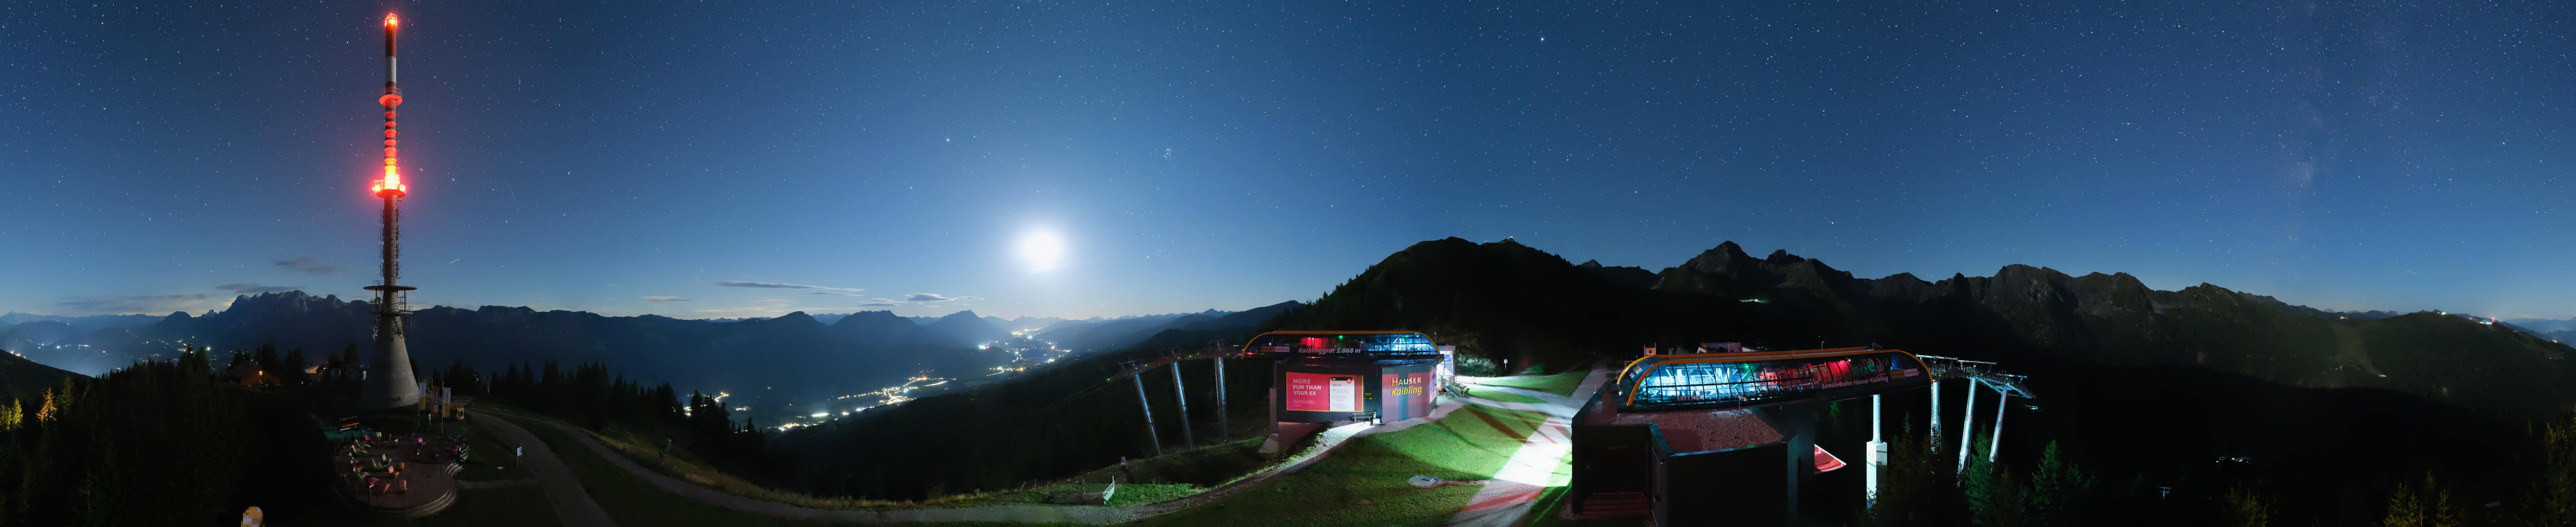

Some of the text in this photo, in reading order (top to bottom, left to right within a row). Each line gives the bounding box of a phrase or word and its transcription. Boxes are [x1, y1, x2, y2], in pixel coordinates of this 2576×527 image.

[1392, 377, 1421, 386] HAUSER
[1822, 380, 1852, 389] Senderbahn
[1391, 386, 1422, 396] Kaibling
